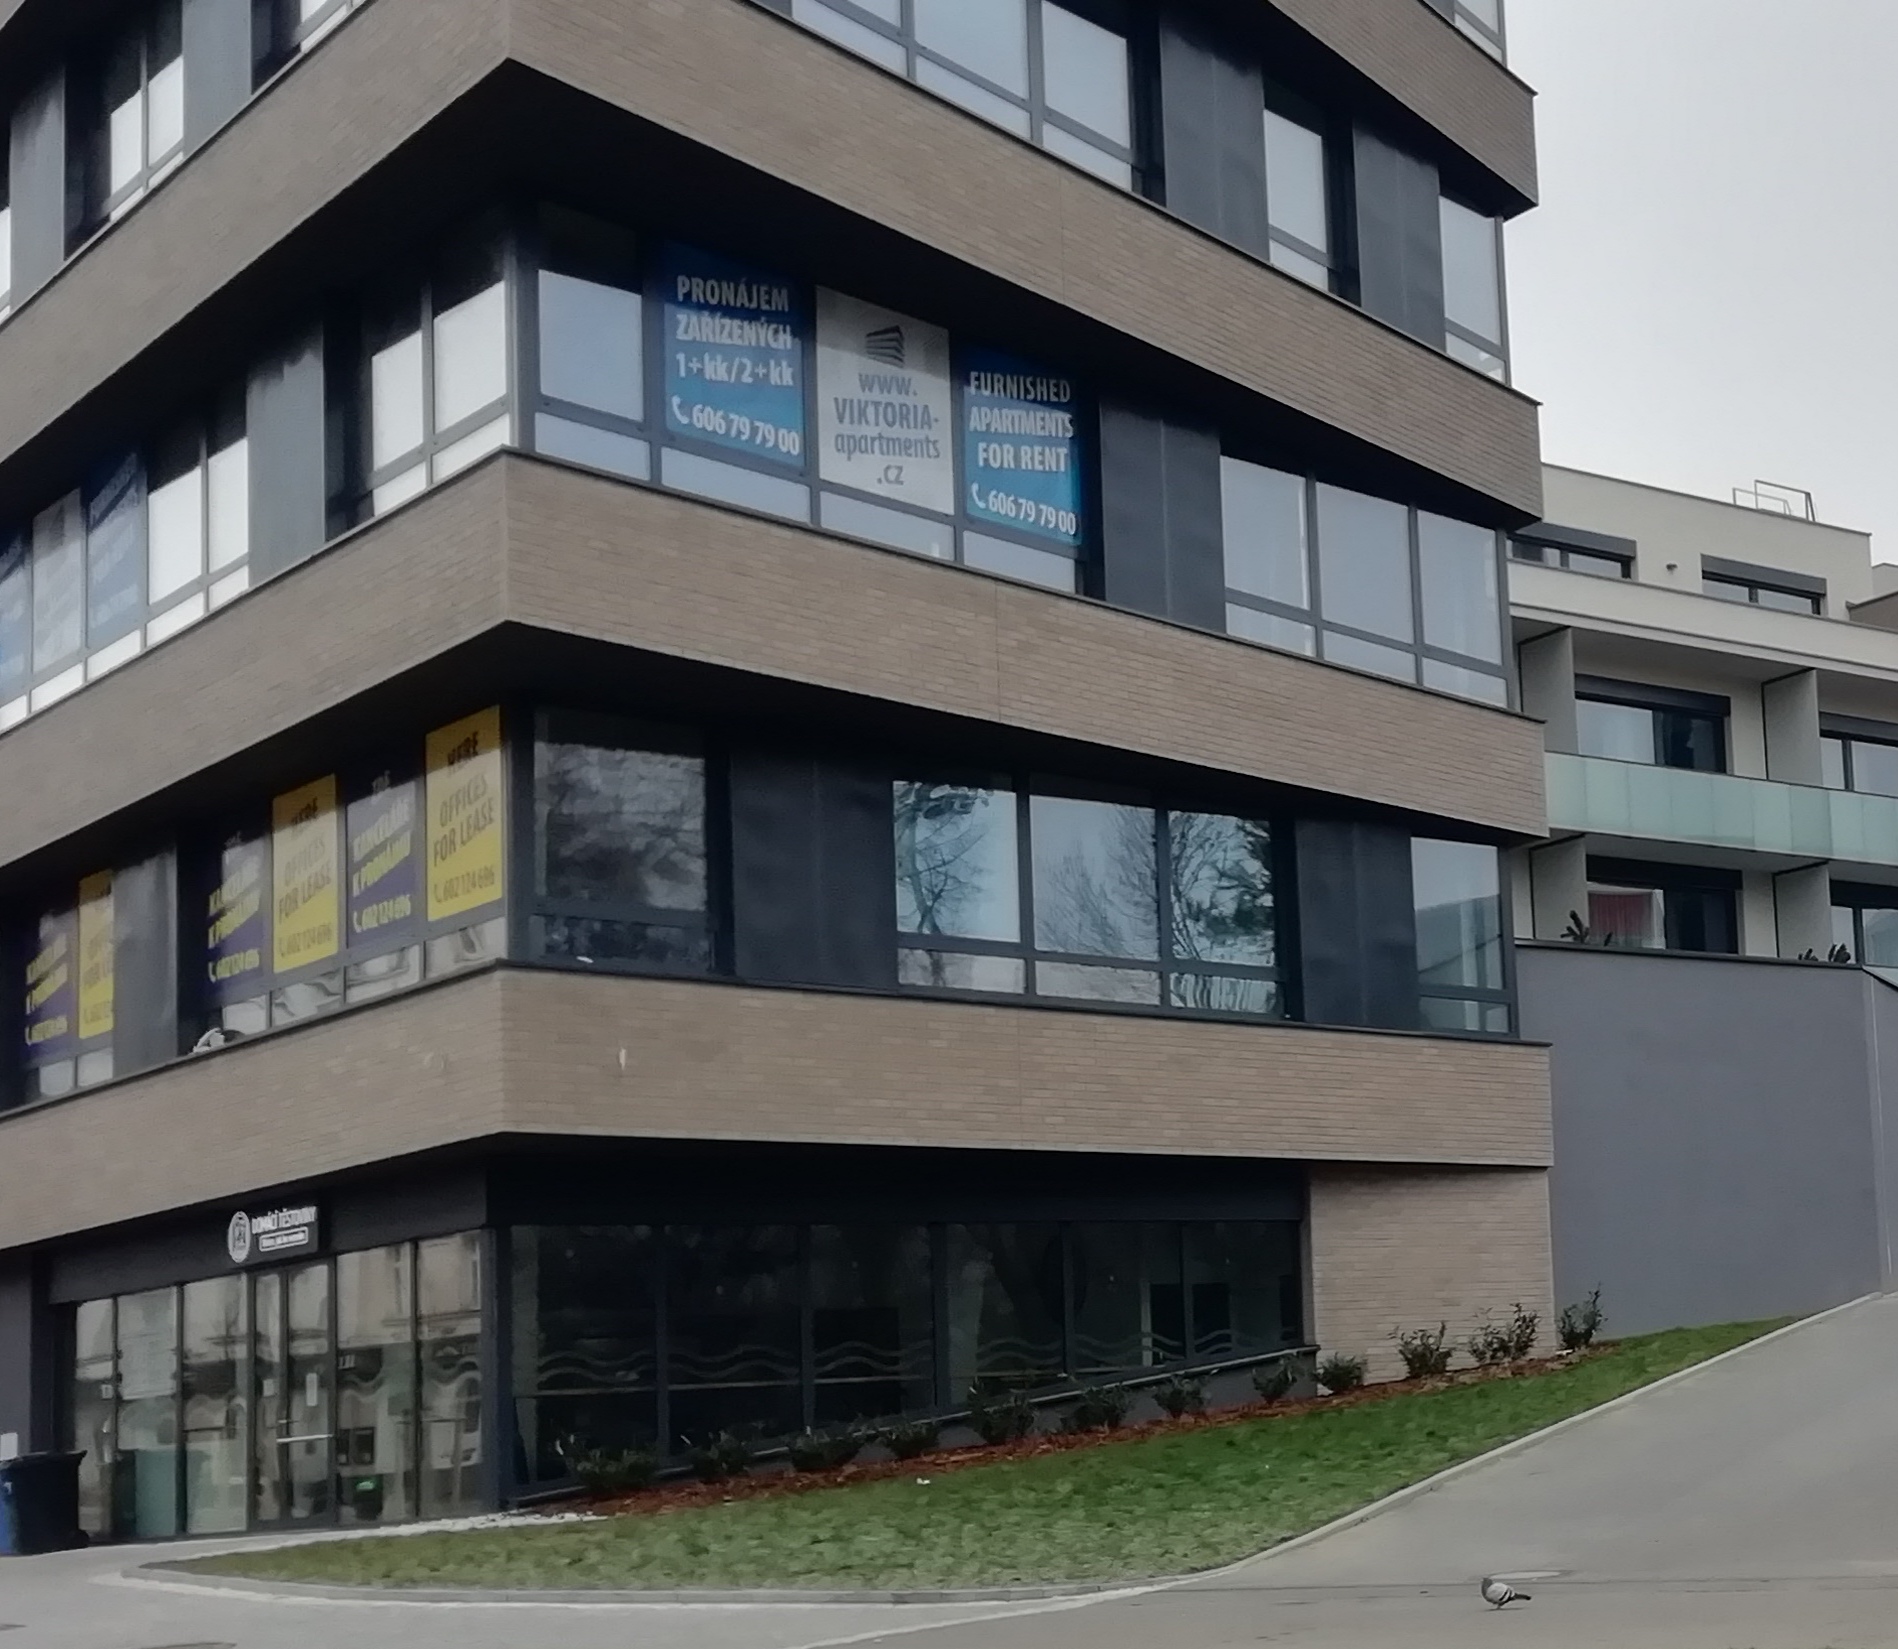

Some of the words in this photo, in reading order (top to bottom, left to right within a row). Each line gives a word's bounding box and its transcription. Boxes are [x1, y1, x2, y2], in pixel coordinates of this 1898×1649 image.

[676, 275, 789, 312] PRONÁJEM
[675, 310, 792, 350] ZAŘÍZENÝCH
[858, 372, 918, 396] www.
[969, 371, 1071, 403] FURNISHED
[692, 404, 726, 435] 606
[729, 412, 750, 441] 79
[754, 421, 775, 448] 79
[778, 429, 799, 456] 00
[833, 397, 939, 430] VIKTORIA-
[969, 406, 1074, 438] APARTMENTS
[834, 432, 940, 461] apartments
[978, 442, 1014, 469] FOR
[1020, 445, 1068, 472] RENT
[988, 490, 1016, 518] 606
[1018, 499, 1036, 523] 79
[1039, 504, 1056, 529] 79
[1058, 512, 1077, 535] 00
[439, 774, 488, 827] OFFICES
[433, 834, 457, 867] FOR
[460, 800, 494, 847] LEASE
